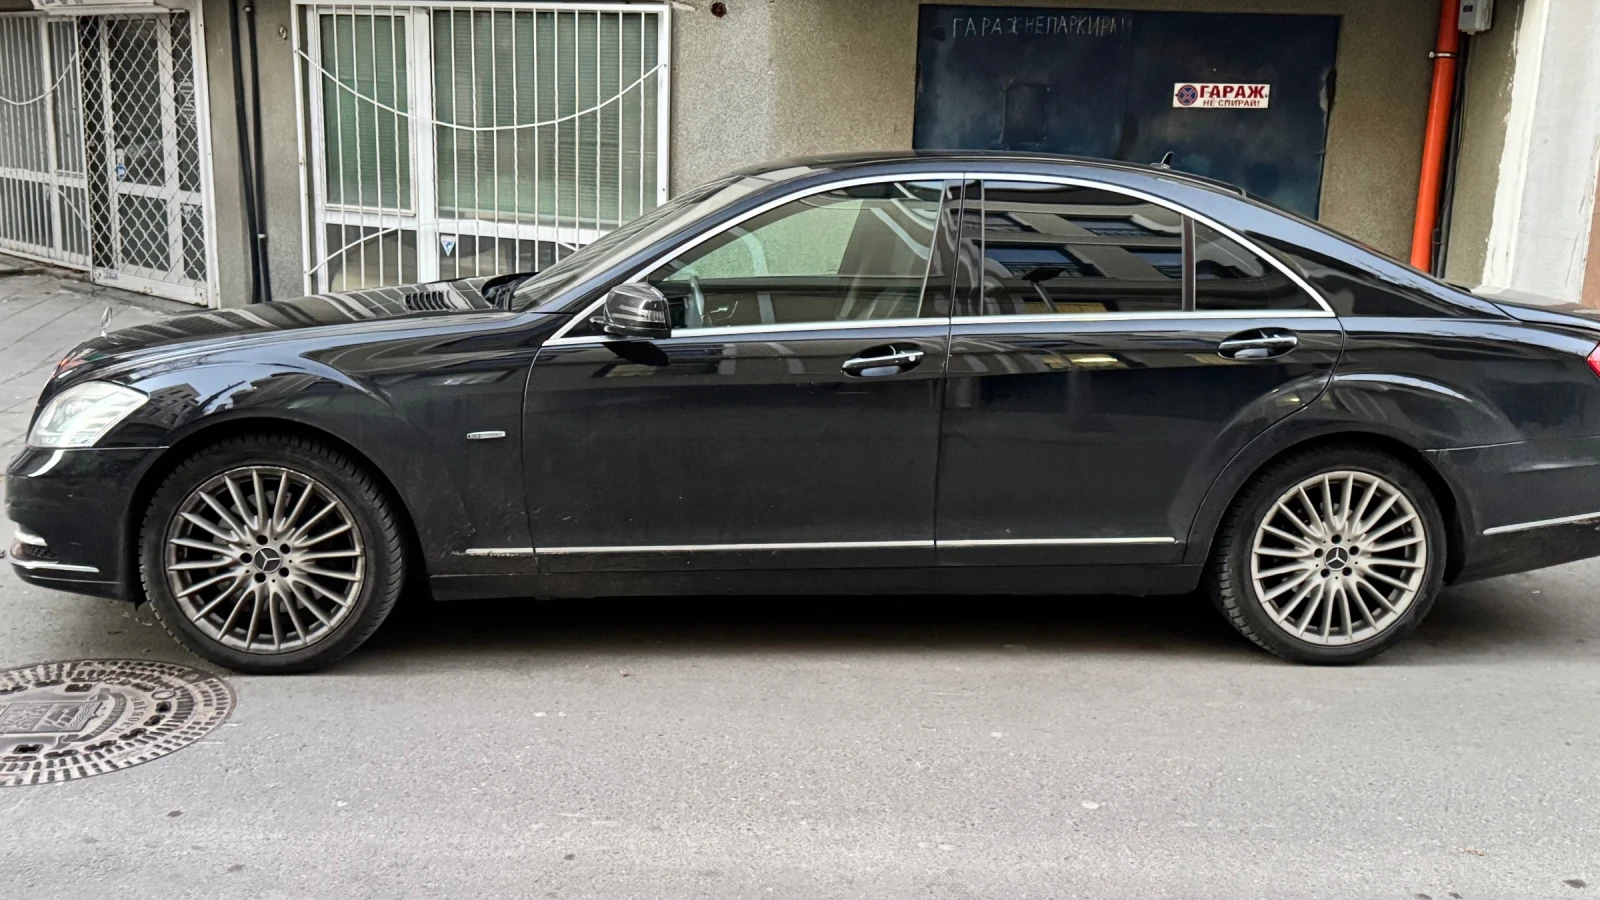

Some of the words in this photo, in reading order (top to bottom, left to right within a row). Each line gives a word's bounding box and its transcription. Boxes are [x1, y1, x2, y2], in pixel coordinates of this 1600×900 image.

[952, 16, 1020, 39] ГАРАЖ
[1199, 85, 1265, 99] ГАРАЖ
[1203, 99, 1216, 107] НЕ
[1218, 99, 1260, 107] СПИРАЙ!
